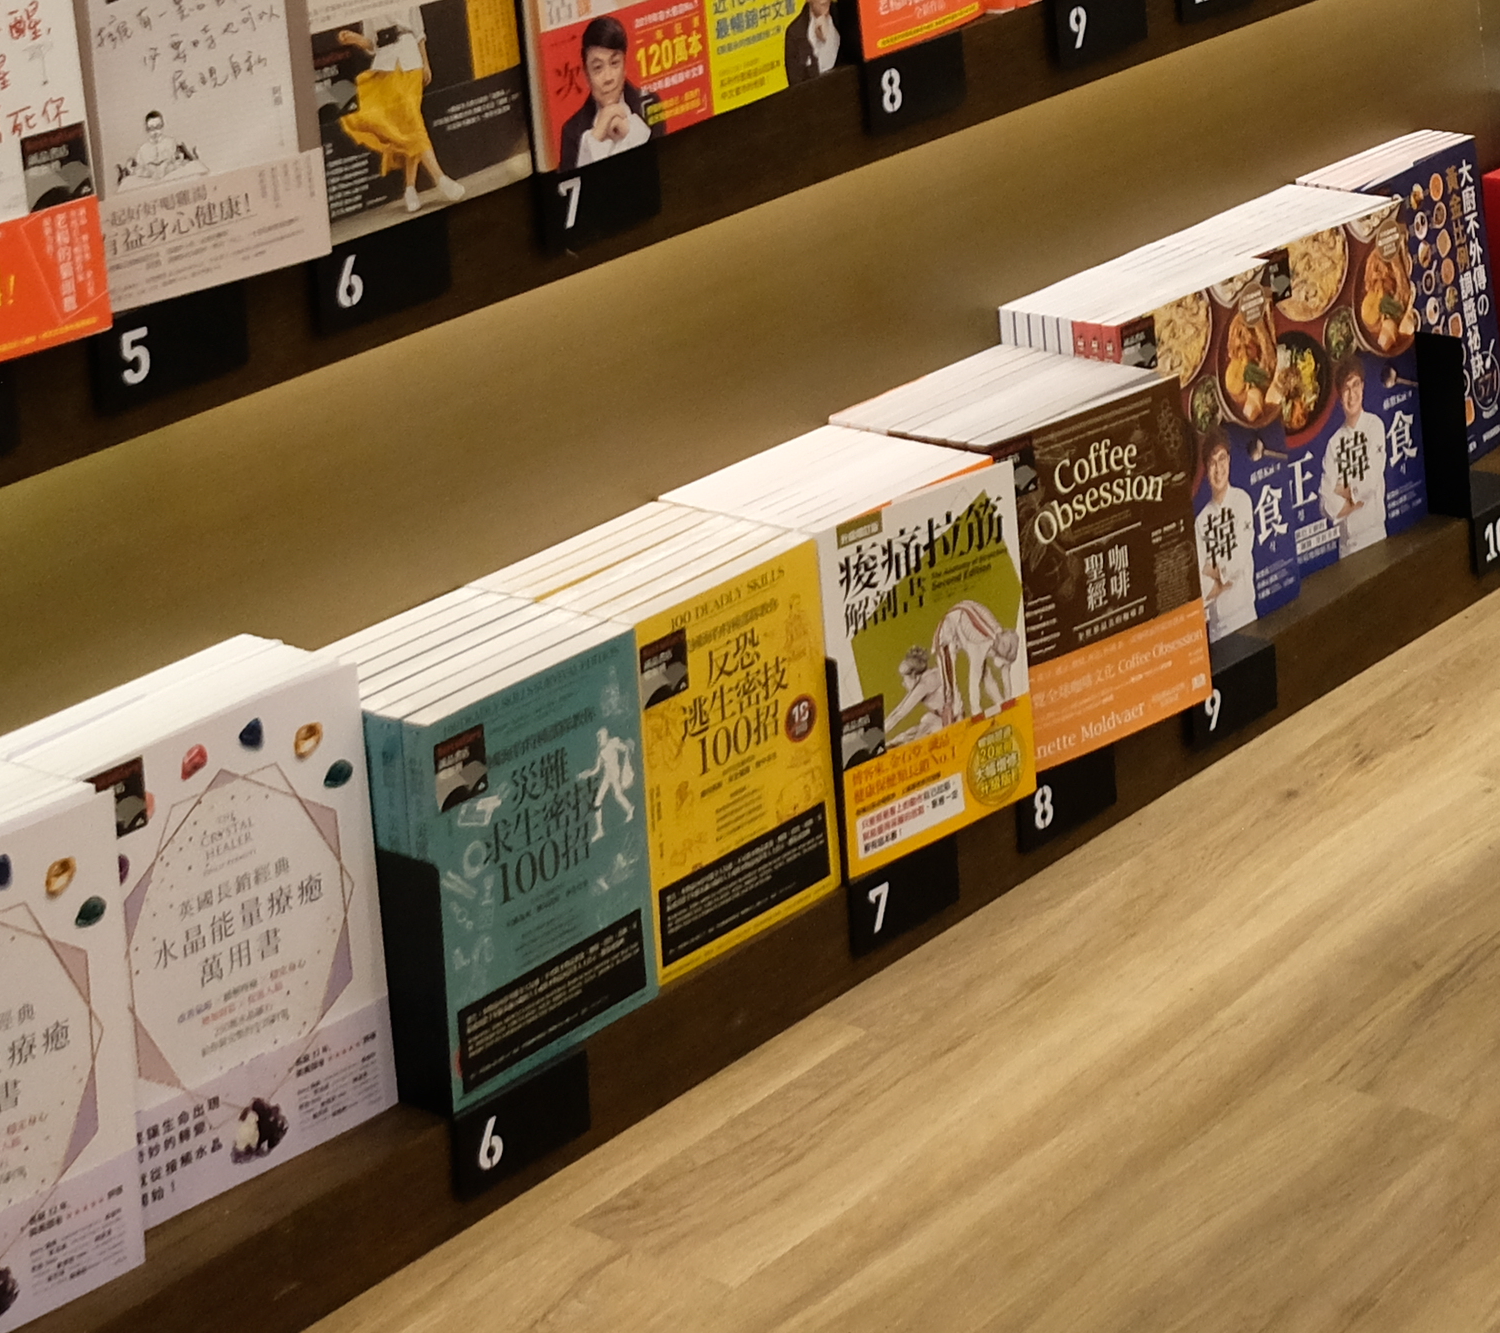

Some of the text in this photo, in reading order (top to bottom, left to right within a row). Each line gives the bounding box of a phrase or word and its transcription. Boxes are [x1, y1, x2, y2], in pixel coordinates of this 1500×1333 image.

[1068, 5, 1088, 50] 9
[880, 67, 903, 114] 8
[556, 178, 583, 229] 7
[335, 254, 365, 309] 6
[121, 327, 151, 386] 5
[1053, 439, 1139, 495] Coffee
[1032, 471, 1164, 547] Obsession
[836, 495, 1005, 600] 痠痛拉筋
[693, 580, 743, 623] DEADLY
[745, 564, 785, 597] SKILLS
[705, 628, 761, 691] 反恐
[1117, 628, 1204, 675] Coffee Obsession
[680, 656, 790, 742] 逃生密技
[1080, 701, 1146, 744] Moldvaer
[1203, 687, 1223, 733] 9
[698, 703, 780, 777] 100招
[1033, 784, 1054, 830] 8
[177, 855, 291, 922] 英國長銷經典
[867, 880, 889, 935] 7
[153, 871, 324, 970] 水晶能量療癒
[199, 926, 283, 988] 萬用書
[477, 1115, 505, 1171] 6
